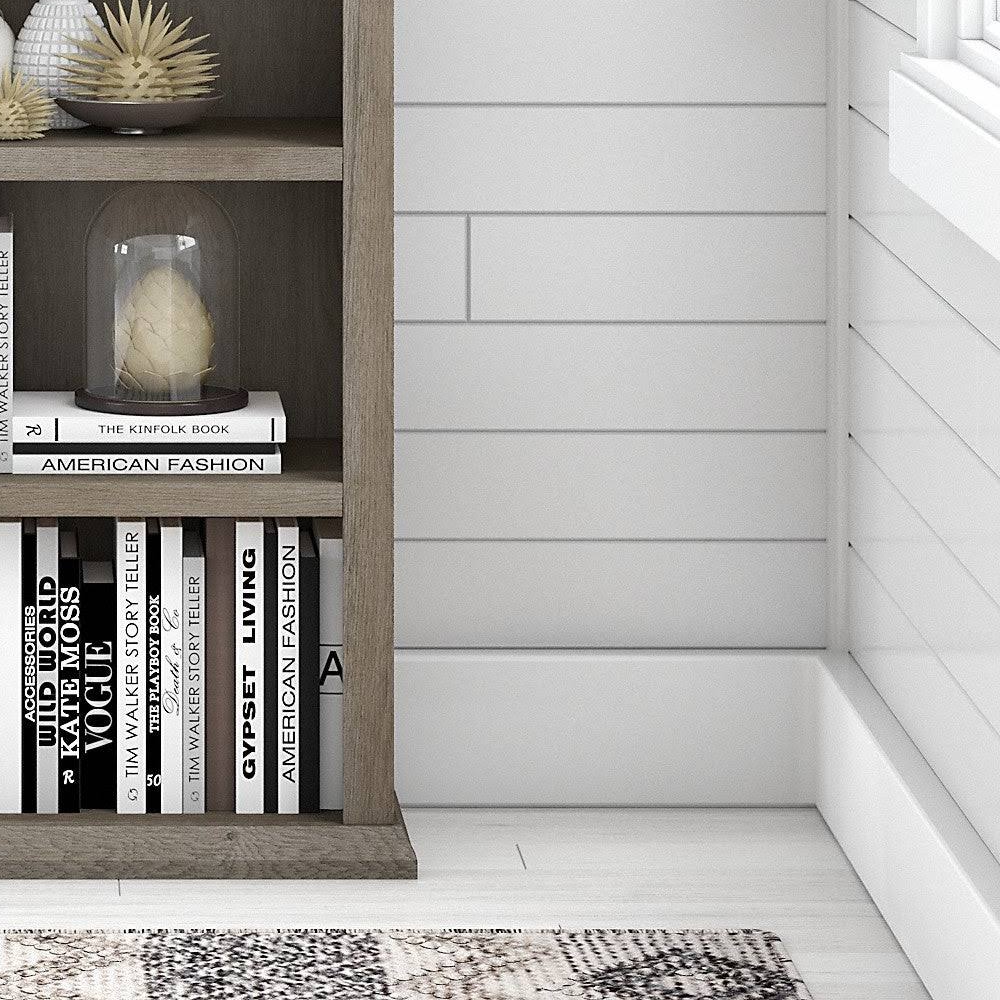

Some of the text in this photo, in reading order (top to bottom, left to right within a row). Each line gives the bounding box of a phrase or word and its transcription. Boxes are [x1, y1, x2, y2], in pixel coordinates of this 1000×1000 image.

[42, 458, 264, 471] AMERICAN FASHION
[98, 425, 229, 434] THE KINFOLK BOOK
[24, 605, 36, 722] ACCESSORIES
[38, 576, 57, 747] WILD WORLD
[60, 586, 80, 759] KATE MOSS
[125, 532, 139, 778] TIM WALKER STORY TELLER
[149, 594, 160, 733] THE PLAYBOY BOOK
[162, 608, 180, 632] Co
[189, 576, 200, 782] TIM WALKER STORY TELLER
[243, 548, 256, 780] GYPSET LIVING
[282, 545, 296, 783] AMERICAN FASHION
[84, 640, 113, 754] VOGUE
[163, 656, 180, 716] Death
[146, 774, 162, 787] 50
